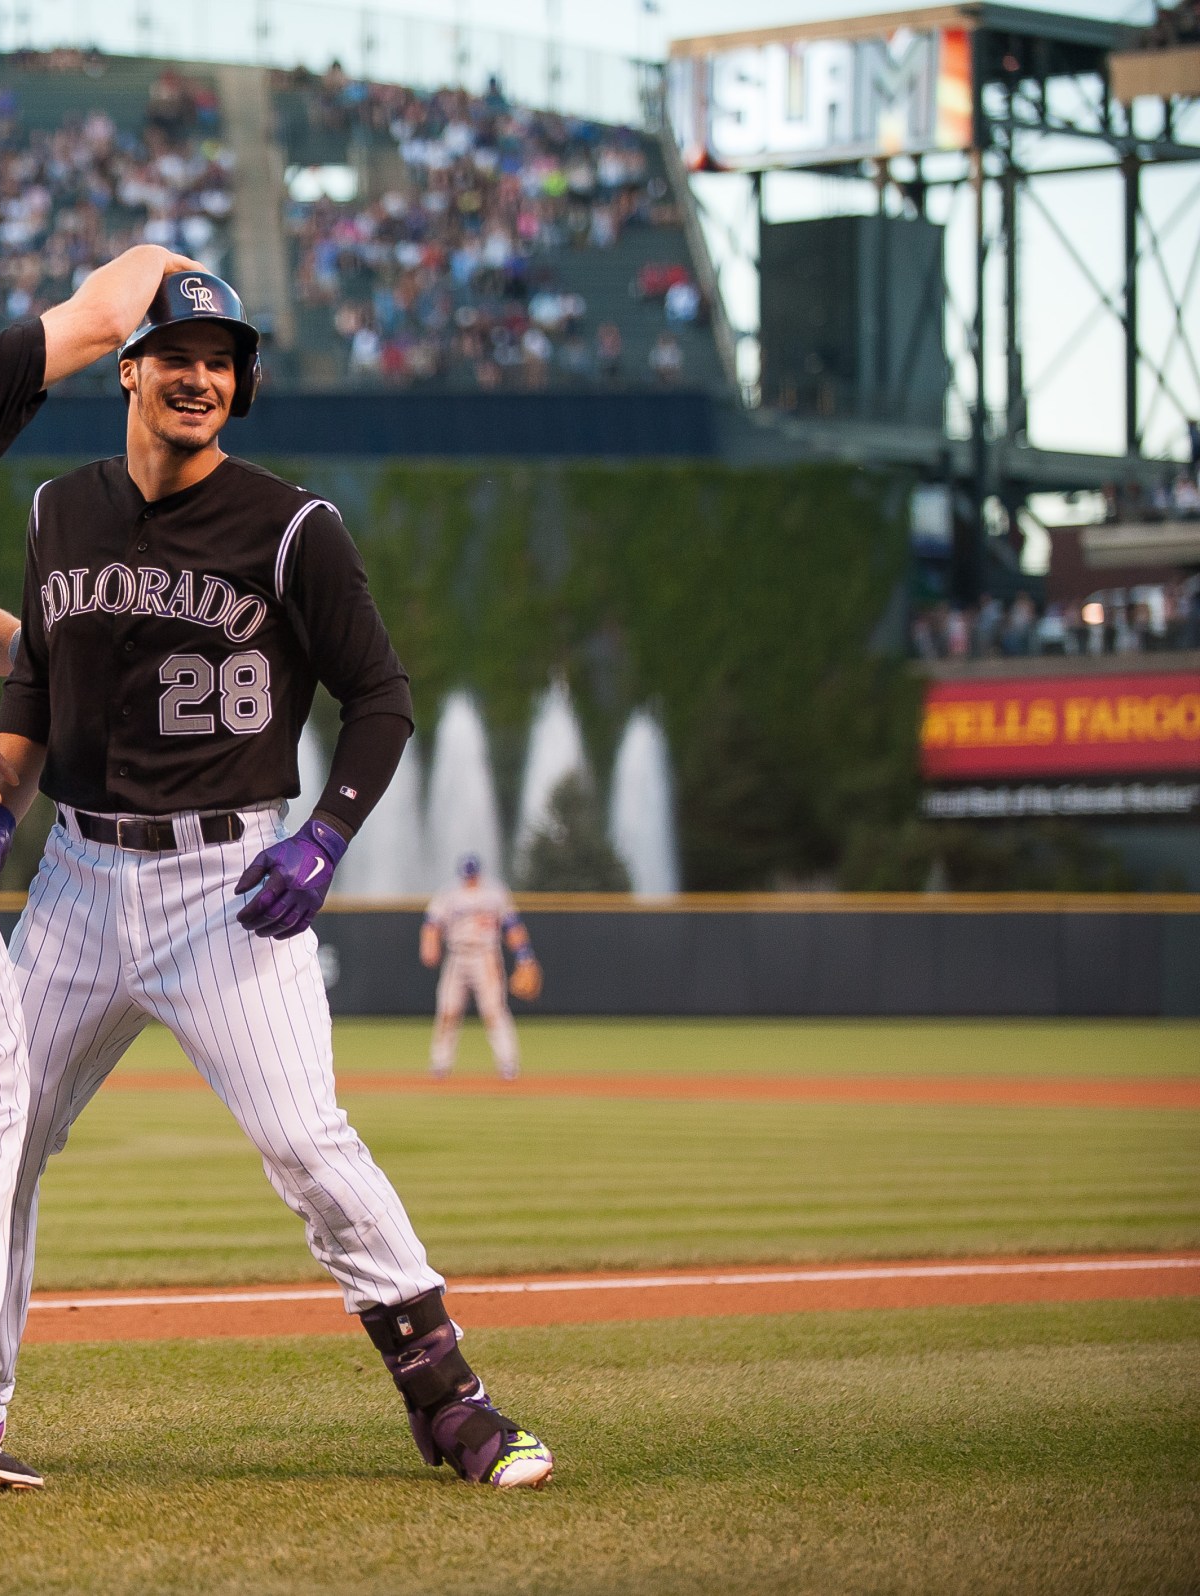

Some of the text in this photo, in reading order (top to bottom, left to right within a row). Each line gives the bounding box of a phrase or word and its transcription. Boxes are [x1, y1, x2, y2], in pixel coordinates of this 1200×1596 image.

[707, 30, 940, 158] SLAM
[180, 277, 218, 312] CR
[40, 562, 268, 643] COLORADO
[159, 650, 273, 736] 28
[1064, 692, 1200, 745] FARGO
